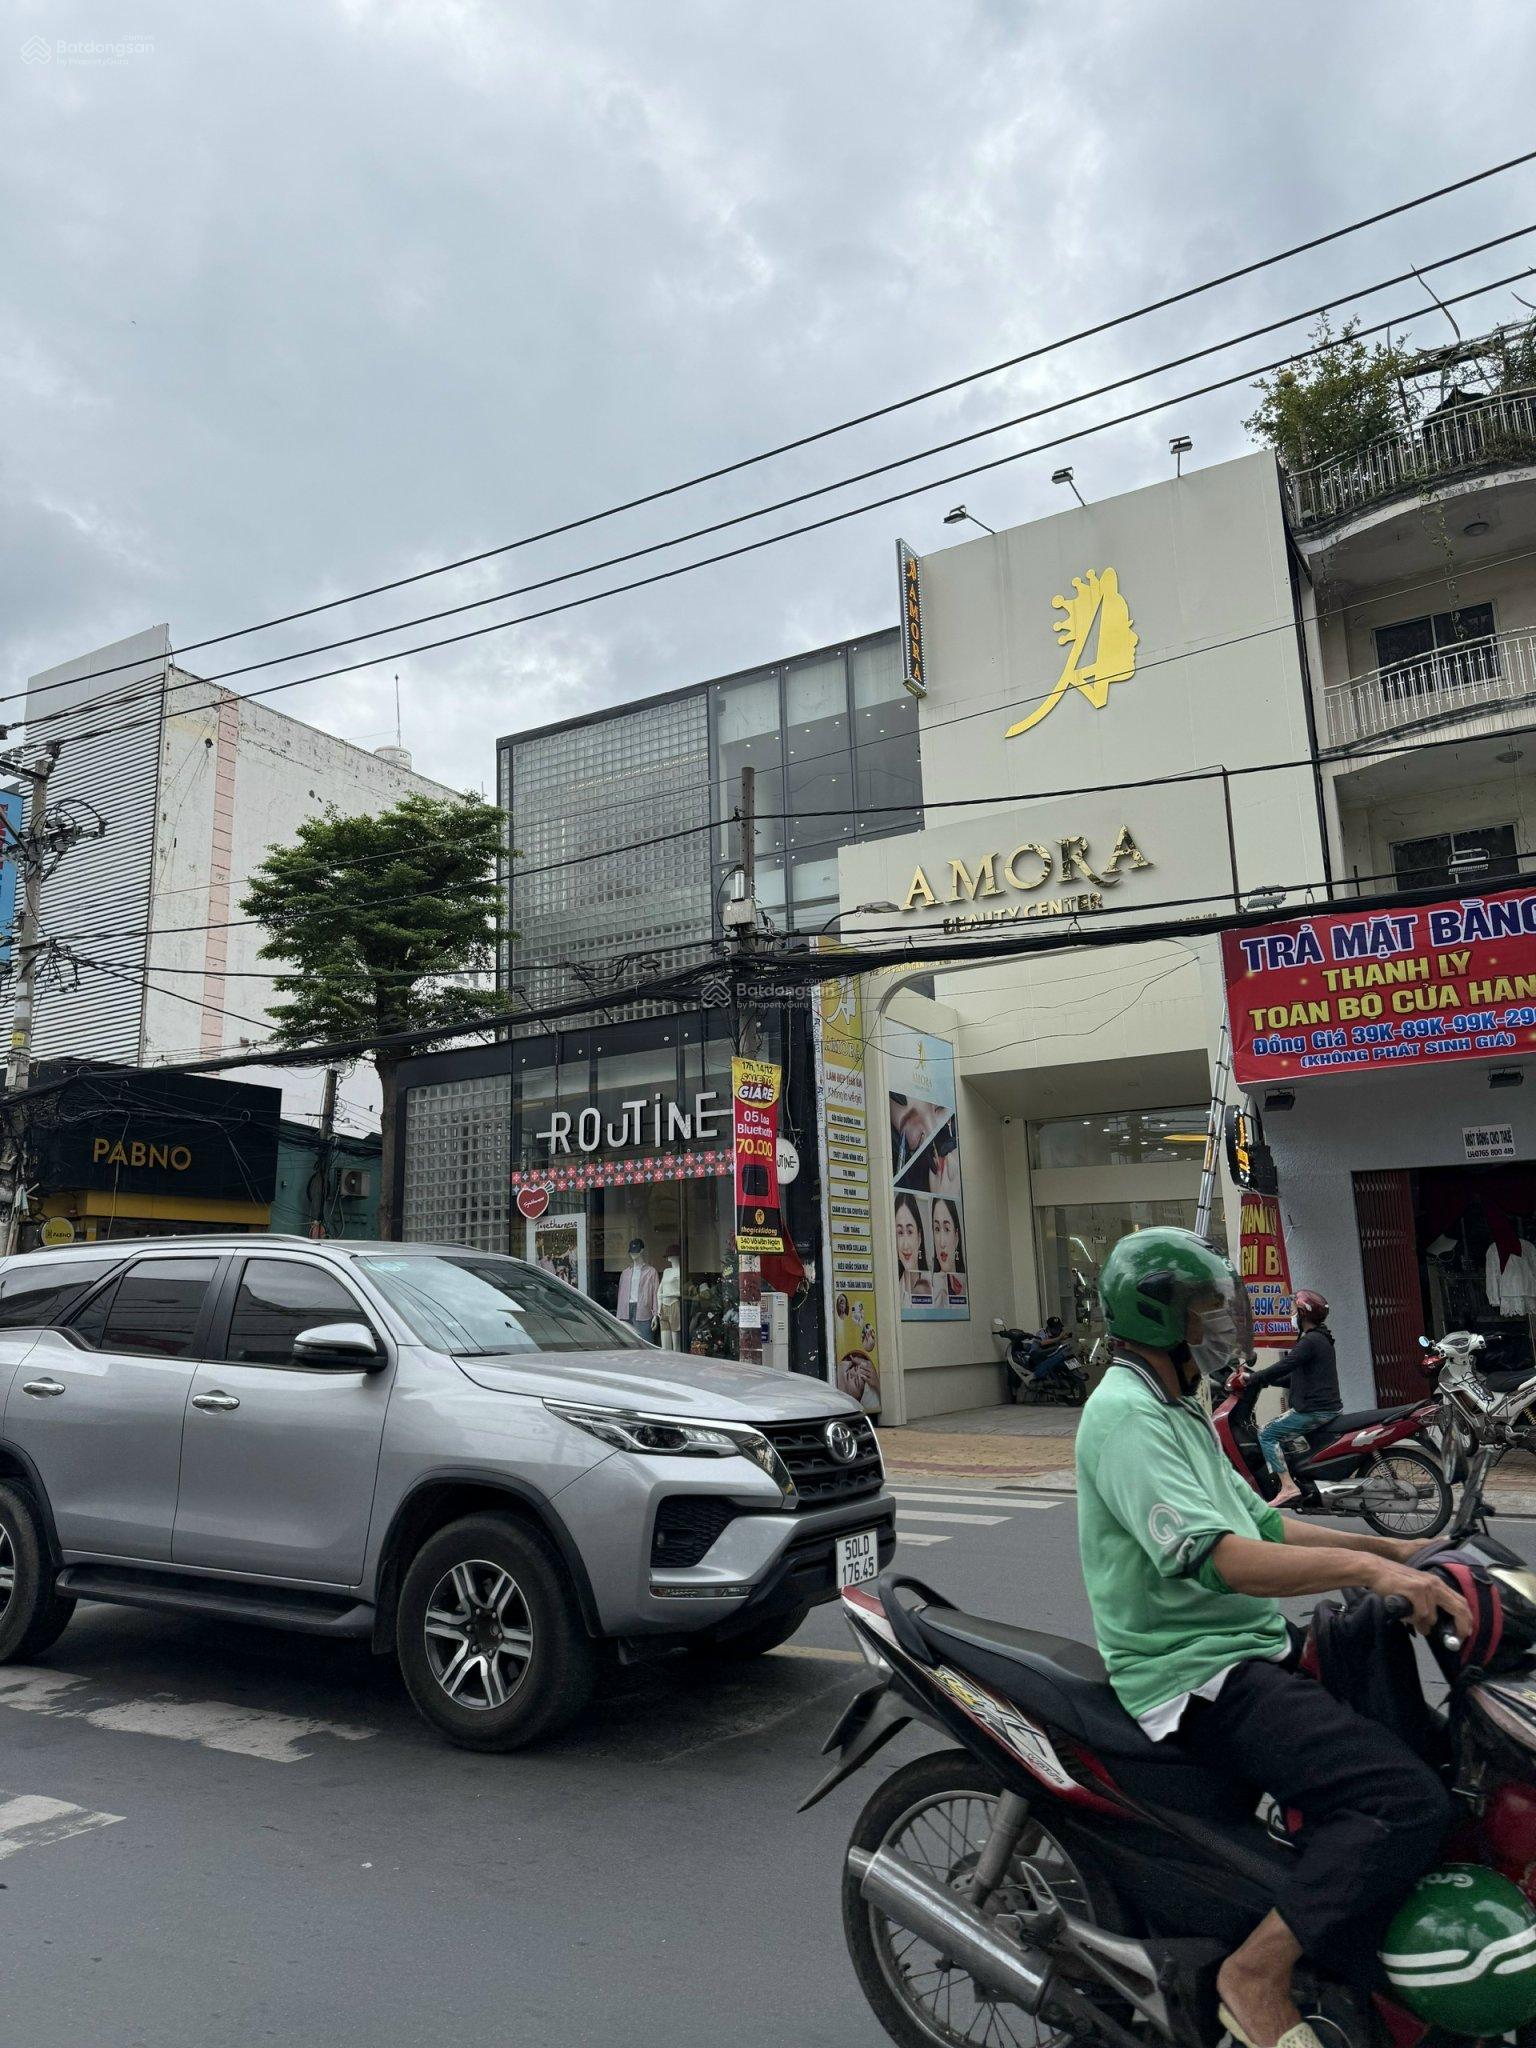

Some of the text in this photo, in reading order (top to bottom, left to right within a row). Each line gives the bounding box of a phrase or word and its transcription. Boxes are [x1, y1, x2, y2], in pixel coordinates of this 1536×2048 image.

[900, 823, 1154, 912] AMORA
[943, 893, 1104, 934] BEAUTY CENTER
[1240, 923, 1326, 973] TRẢ
[1330, 914, 1418, 959] MẶT
[1322, 957, 1430, 992] THANH
[1339, 992, 1384, 1020] BỘ
[1392, 983, 1461, 1014] CỬA
[1253, 1032, 1306, 1057] Đồng
[1312, 1029, 1348, 1049] Giá
[1374, 1042, 1421, 1059] PHÁT
[1425, 1037, 1472, 1054] SINH
[1475, 1032, 1517, 1049] GIÁ)
[741, 1073, 762, 1084] SALE
[737, 1123, 773, 1138] Bluetooth
[743, 1110, 759, 1122] 05
[93, 1138, 192, 1171] PABNO
[1267, 1321, 1291, 1333] SINH
[844, 1534, 871, 1561] 50LD
[842, 1555, 875, 1586] 176.45
